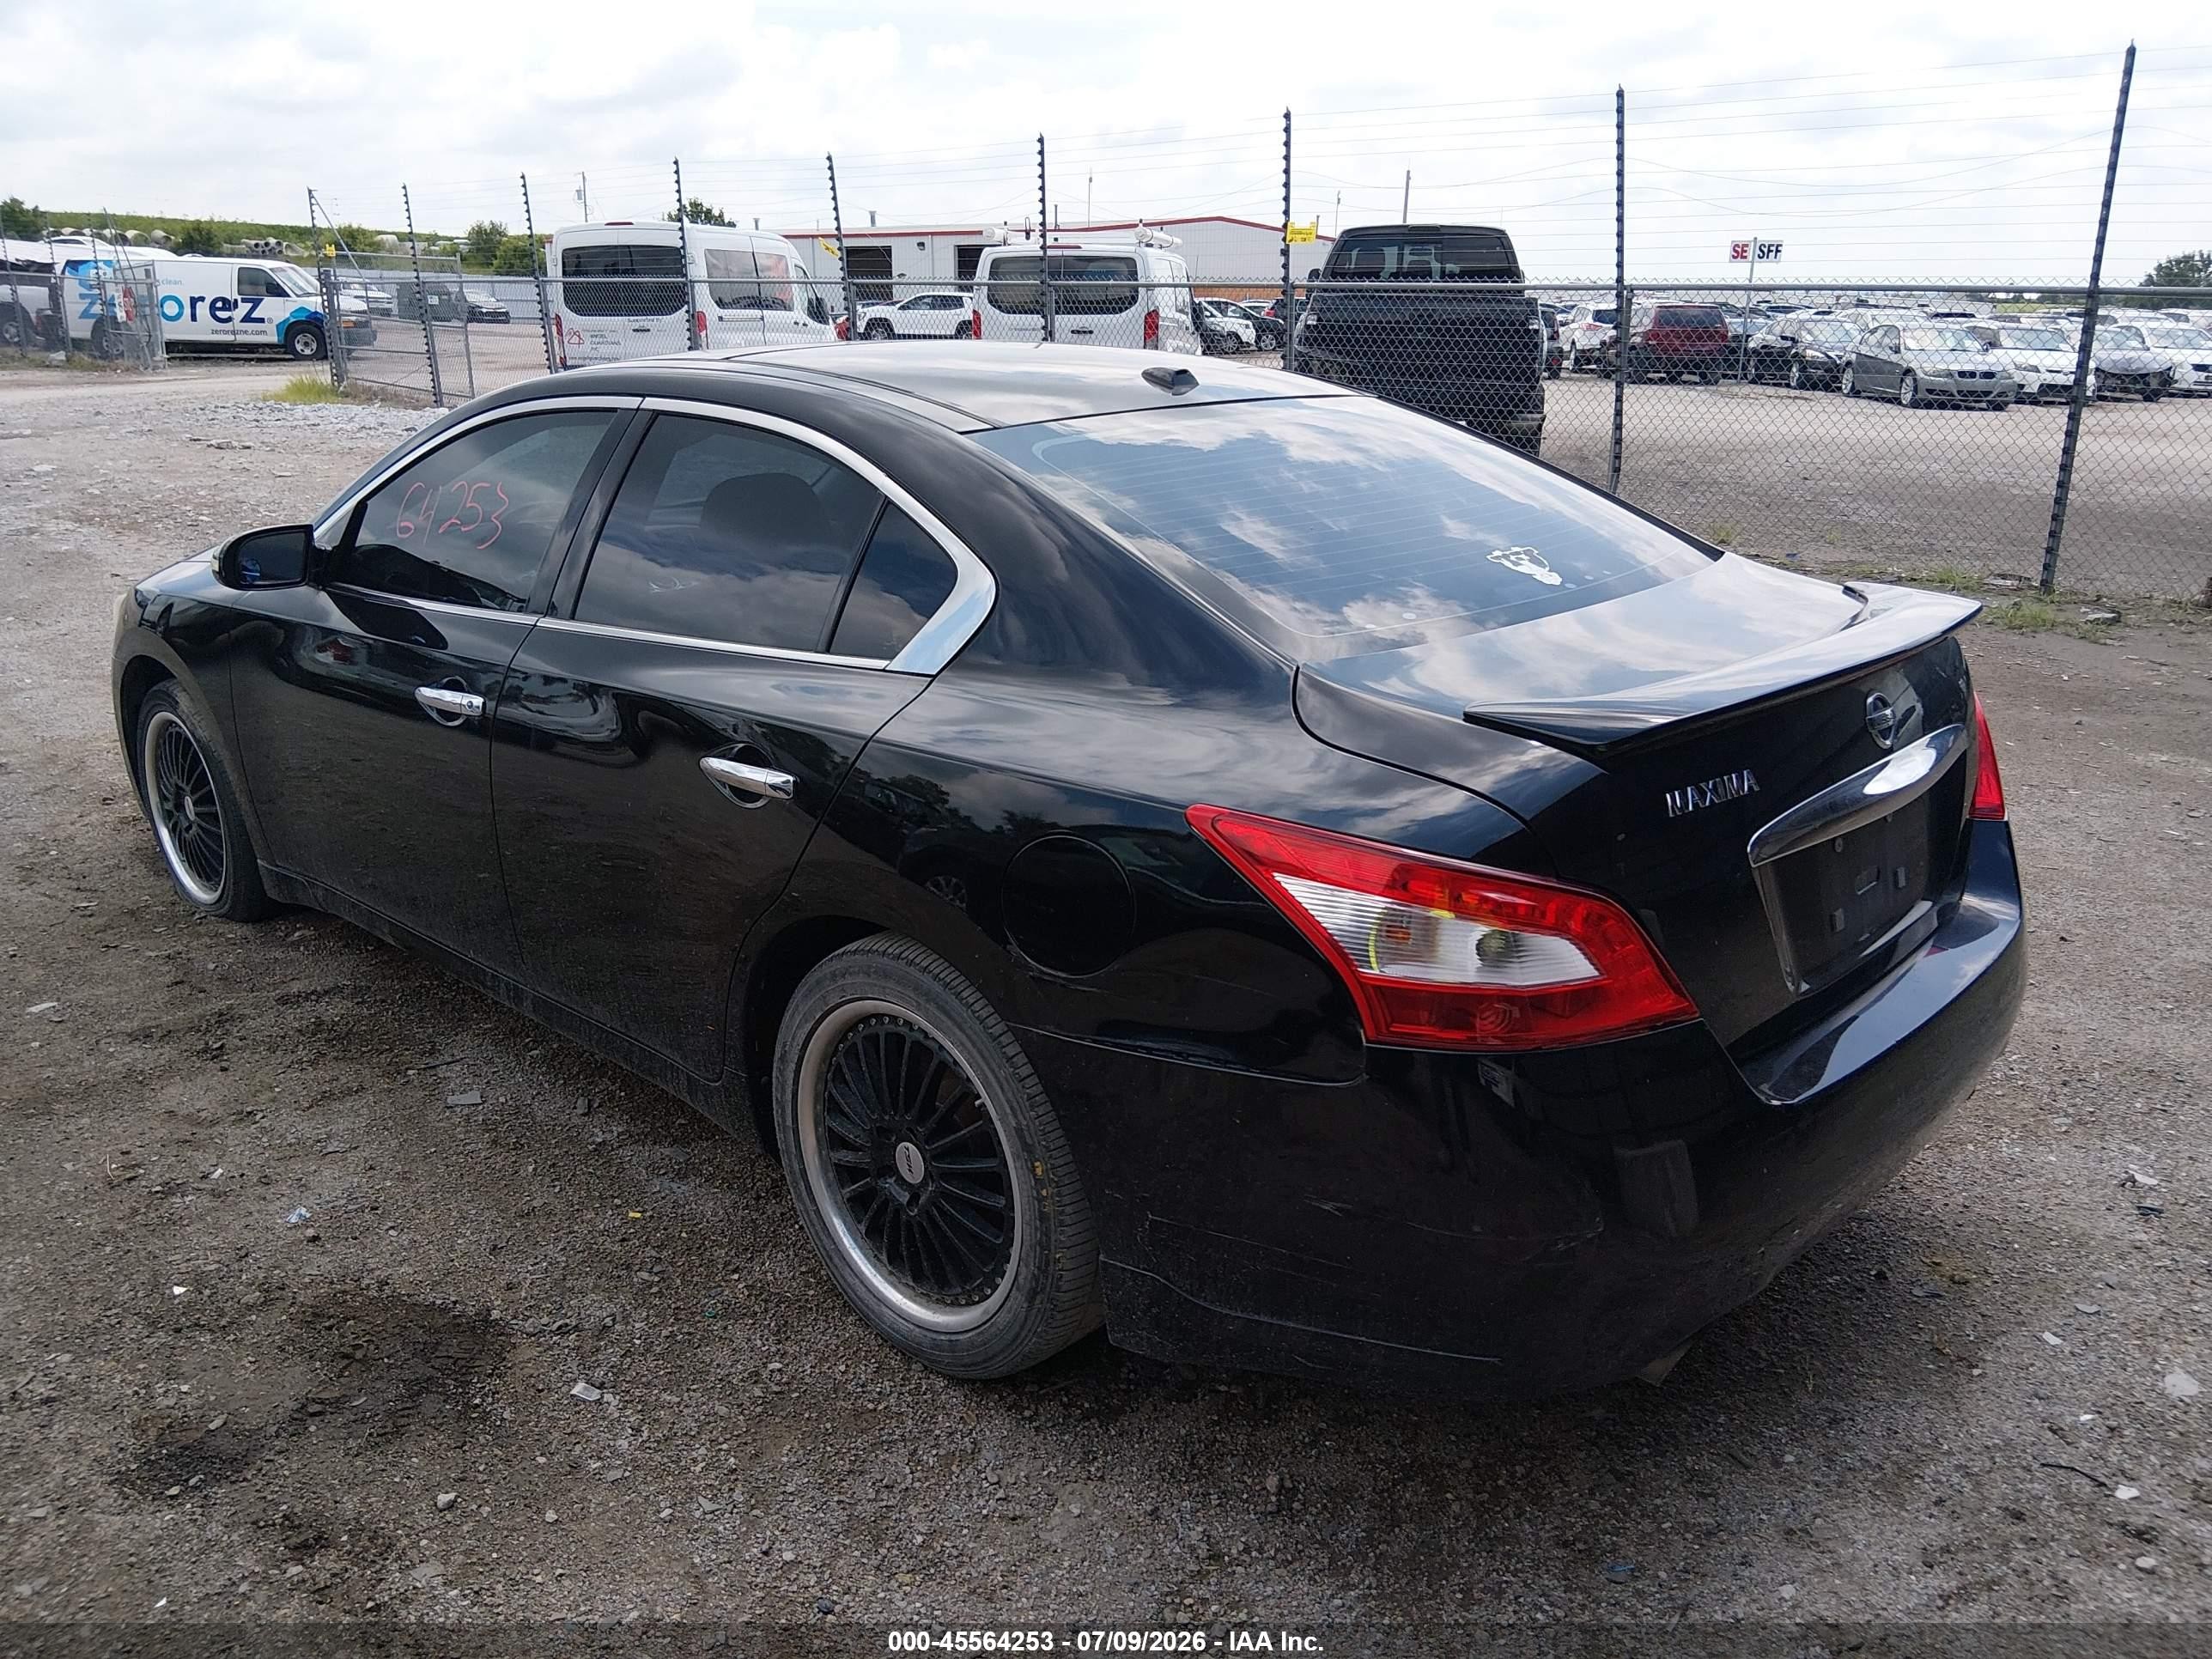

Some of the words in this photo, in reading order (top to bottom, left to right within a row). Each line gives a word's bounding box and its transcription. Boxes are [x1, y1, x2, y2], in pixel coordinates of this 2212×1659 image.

[1732, 243, 1749, 259] SE
[1757, 243, 1784, 259] SFF
[396, 481, 510, 550] 64253
[1665, 769, 1761, 817] MAXIMA
